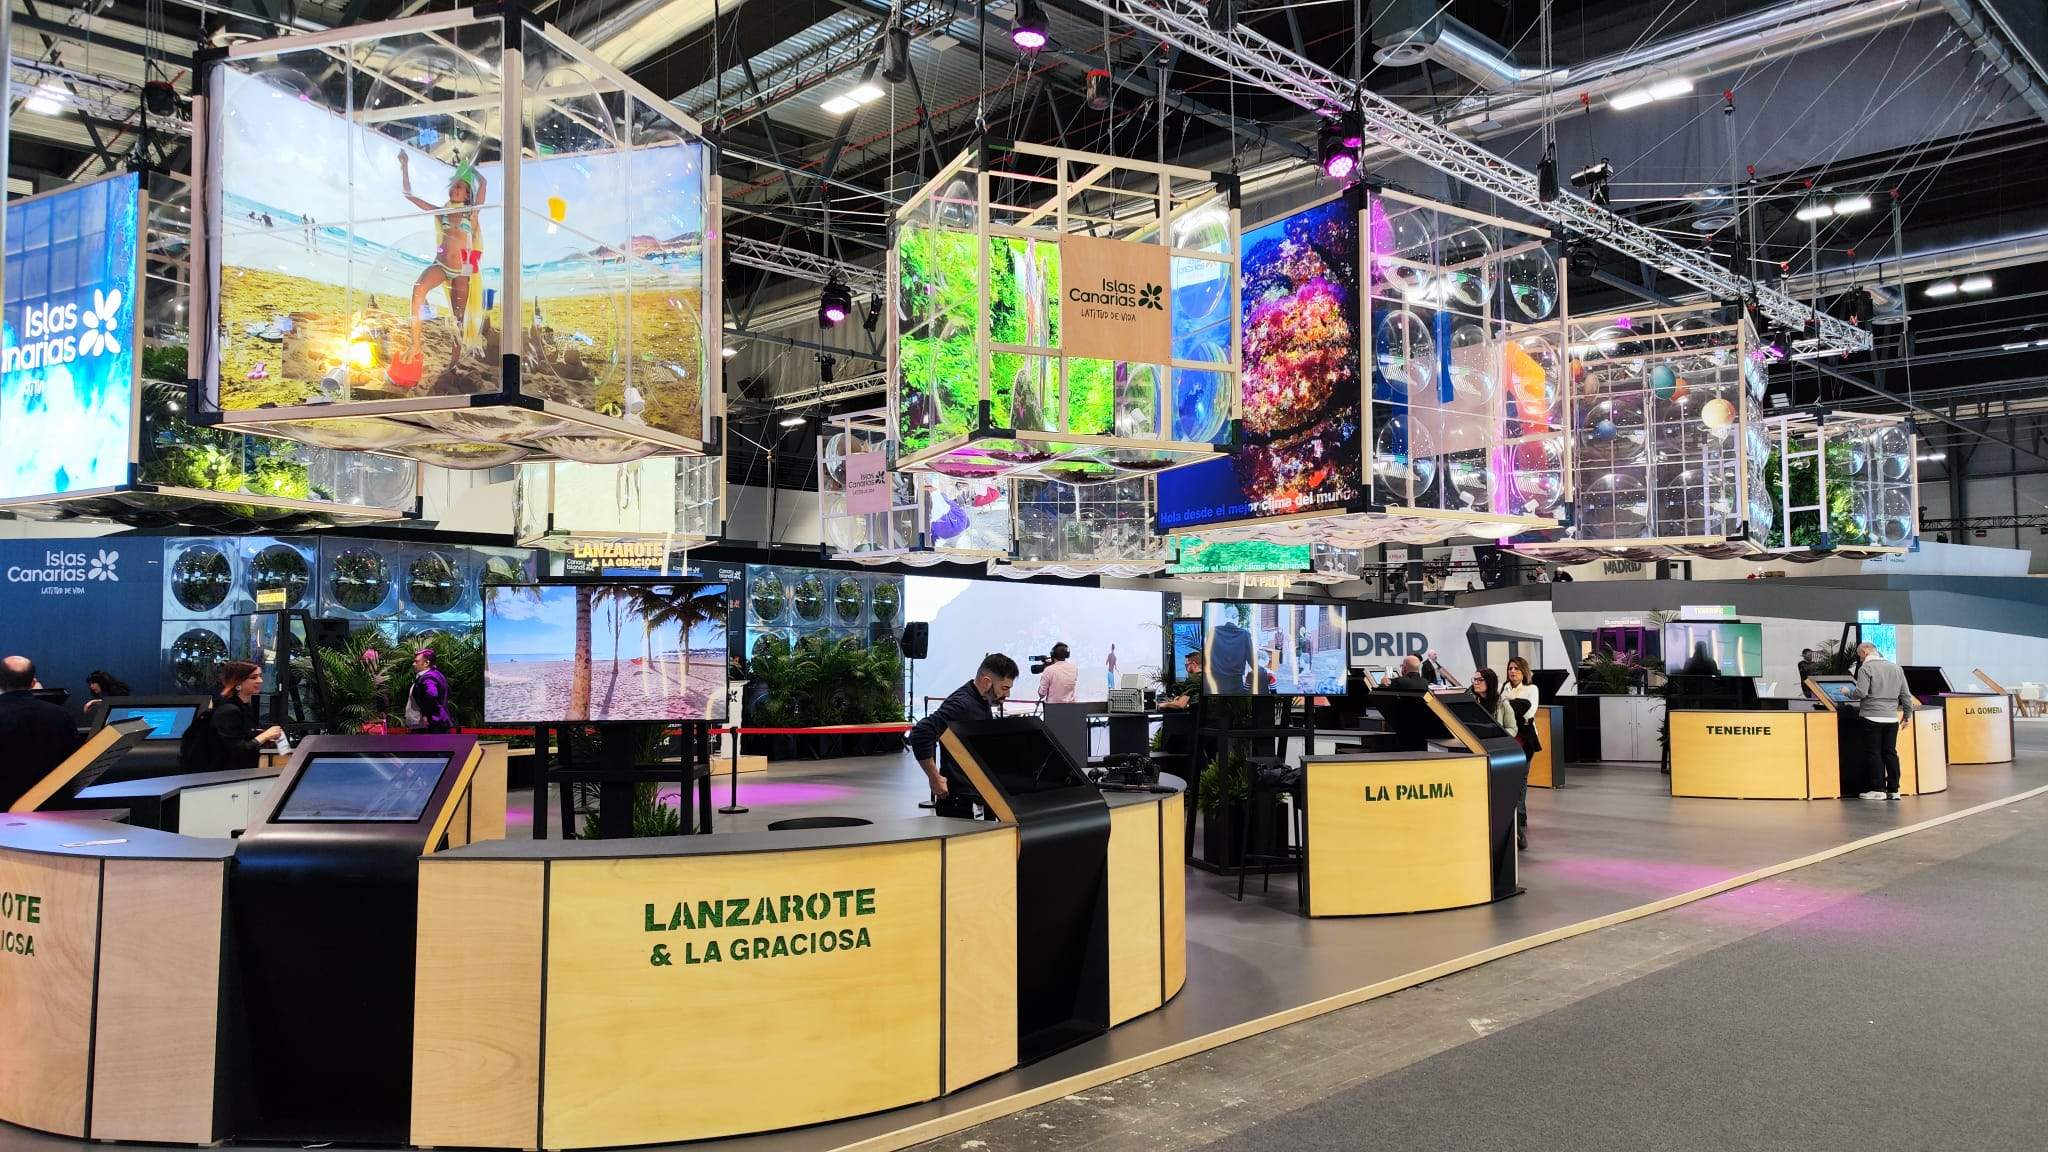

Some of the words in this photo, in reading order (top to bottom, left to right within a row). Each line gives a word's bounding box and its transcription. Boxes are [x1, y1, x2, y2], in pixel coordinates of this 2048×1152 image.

[1102, 278, 1136, 294] Islas
[1069, 288, 1136, 307] Canarias
[25, 302, 78, 338] Islas
[1111, 312, 1119, 320] DE
[1121, 313, 1136, 321] VIDA
[1160, 511, 1182, 524] Hola
[1184, 506, 1213, 520] desde
[1216, 504, 1225, 516] el
[1228, 501, 1259, 516] mejor
[1261, 495, 1291, 512] clima
[1295, 492, 1313, 506] del
[46, 550, 87, 566] Islas
[574, 543, 663, 559] LANZAROTE
[602, 559, 613, 567] LA
[616, 558, 663, 567] GRACIOSA
[8, 565, 86, 582] Canarias
[1347, 632, 1429, 657] DRID
[1706, 726, 1771, 736] TENERIFE
[1365, 785, 1390, 801] LA
[1396, 782, 1454, 800] PALMA
[645, 888, 876, 931] LANZAROTE
[650, 943, 672, 966] &
[685, 941, 722, 964] LA
[730, 927, 871, 960] GRACIOSA
